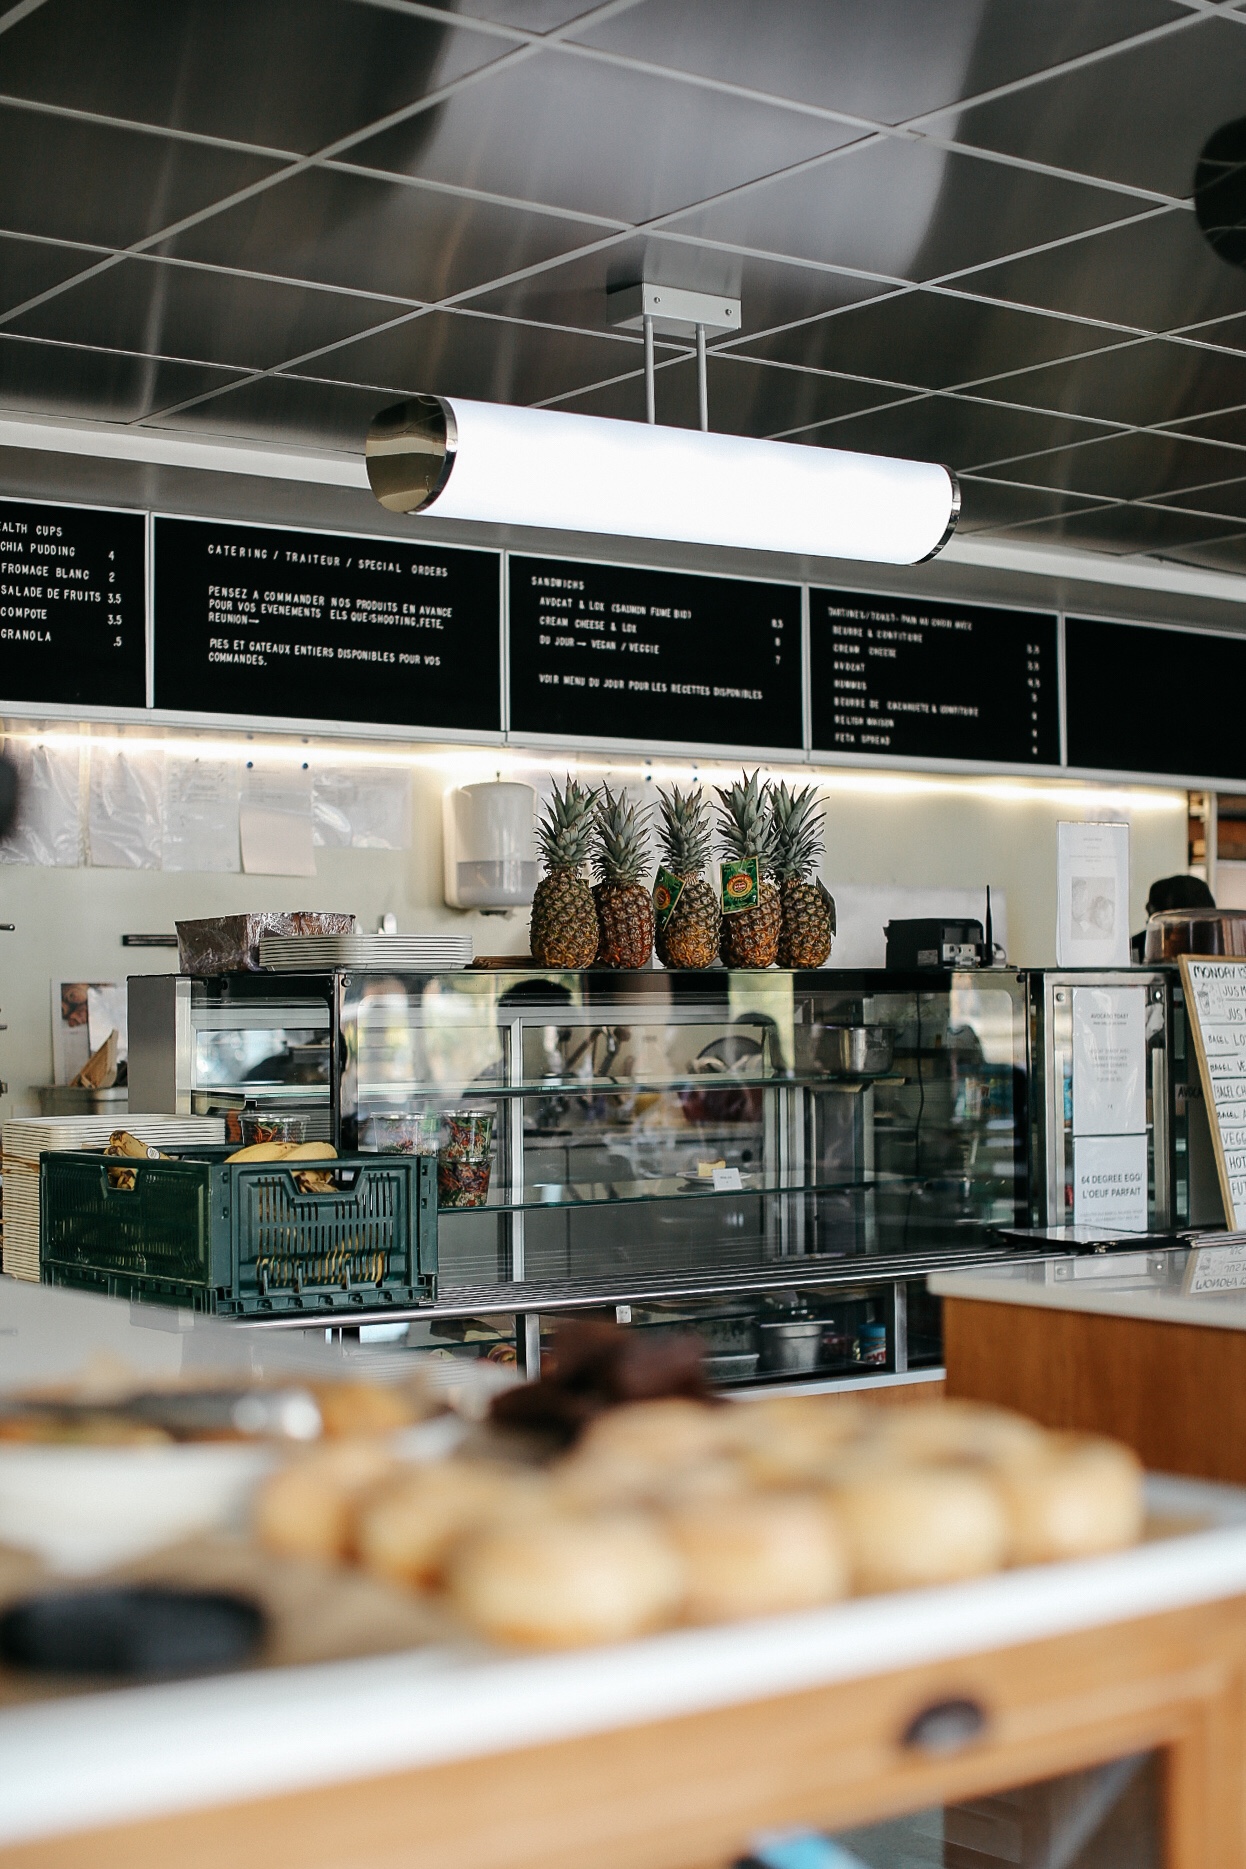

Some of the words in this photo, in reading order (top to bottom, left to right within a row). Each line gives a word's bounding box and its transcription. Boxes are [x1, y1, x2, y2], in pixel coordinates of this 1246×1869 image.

[0, 522, 28, 534] ALTH
[36, 525, 62, 536] CUPS
[0, 541, 23, 552] CHIA
[30, 543, 76, 557] PUDDING
[108, 551, 115, 560] 4
[208, 544, 268, 559] CATERING
[274, 550, 279, 560] /
[286, 551, 340, 566] TRAITEUR
[346, 558, 352, 568] /
[358, 559, 402, 573] SPECIAL
[411, 564, 448, 577] ORDERS
[1, 562, 49, 576] FROMAGE
[56, 567, 90, 580] BLANC
[108, 572, 116, 582] 2
[1, 585, 42, 598] SALADE
[48, 588, 60, 599] DE
[64, 589, 101, 602] FRUITS
[208, 586, 248, 599] PENSEZ
[252, 590, 260, 600] A
[264, 591, 325, 606] COMMANDER
[330, 597, 351, 608] NOS
[356, 598, 398, 613] PRODUITS
[402, 604, 416, 614] EN
[419, 605, 452, 618] AVANCE
[209, 599, 233, 611] POUR
[238, 601, 256, 613] VOS
[261, 604, 322, 619] EVENEMENTS
[330, 610, 348, 620] ELS
[540, 596, 572, 608] AVOCAT
[589, 600, 604, 612] LOX
[0, 607, 47, 620] COMPOTE
[539, 616, 568, 627] CREAM
[574, 619, 605, 631] CHEESE
[622, 622, 637, 634] LOX
[0, 629, 51, 642] GRANOLA
[210, 638, 230, 650] PIES
[234, 640, 245, 650] ET
[294, 644, 334, 658] ENTIERS
[338, 648, 396, 663] DISPONIBLES
[399, 653, 420, 665] POUR
[424, 656, 441, 666] VOS
[539, 634, 551, 645] DU
[591, 639, 616, 650] VEGAN
[628, 642, 660, 655] VEGGIE
[539, 674, 560, 684] VOIR
[563, 675, 586, 686] MENU
[588, 678, 600, 688] DU
[603, 679, 624, 689] JOUR
[628, 680, 650, 691] POUR
[652, 682, 668, 692] LES
[671, 684, 710, 696] RECETTES
[714, 686, 763, 700] DISPONIBLES
[1194, 966, 1235, 979] MONDAY
[1223, 986, 1240, 997] JUS
[1228, 1008, 1244, 1020] JUS
[1092, 1174, 1122, 1184] DEGREE
[1082, 1189, 1109, 1199] L'OEUF
[1112, 1188, 1141, 1196] PARFAIT
